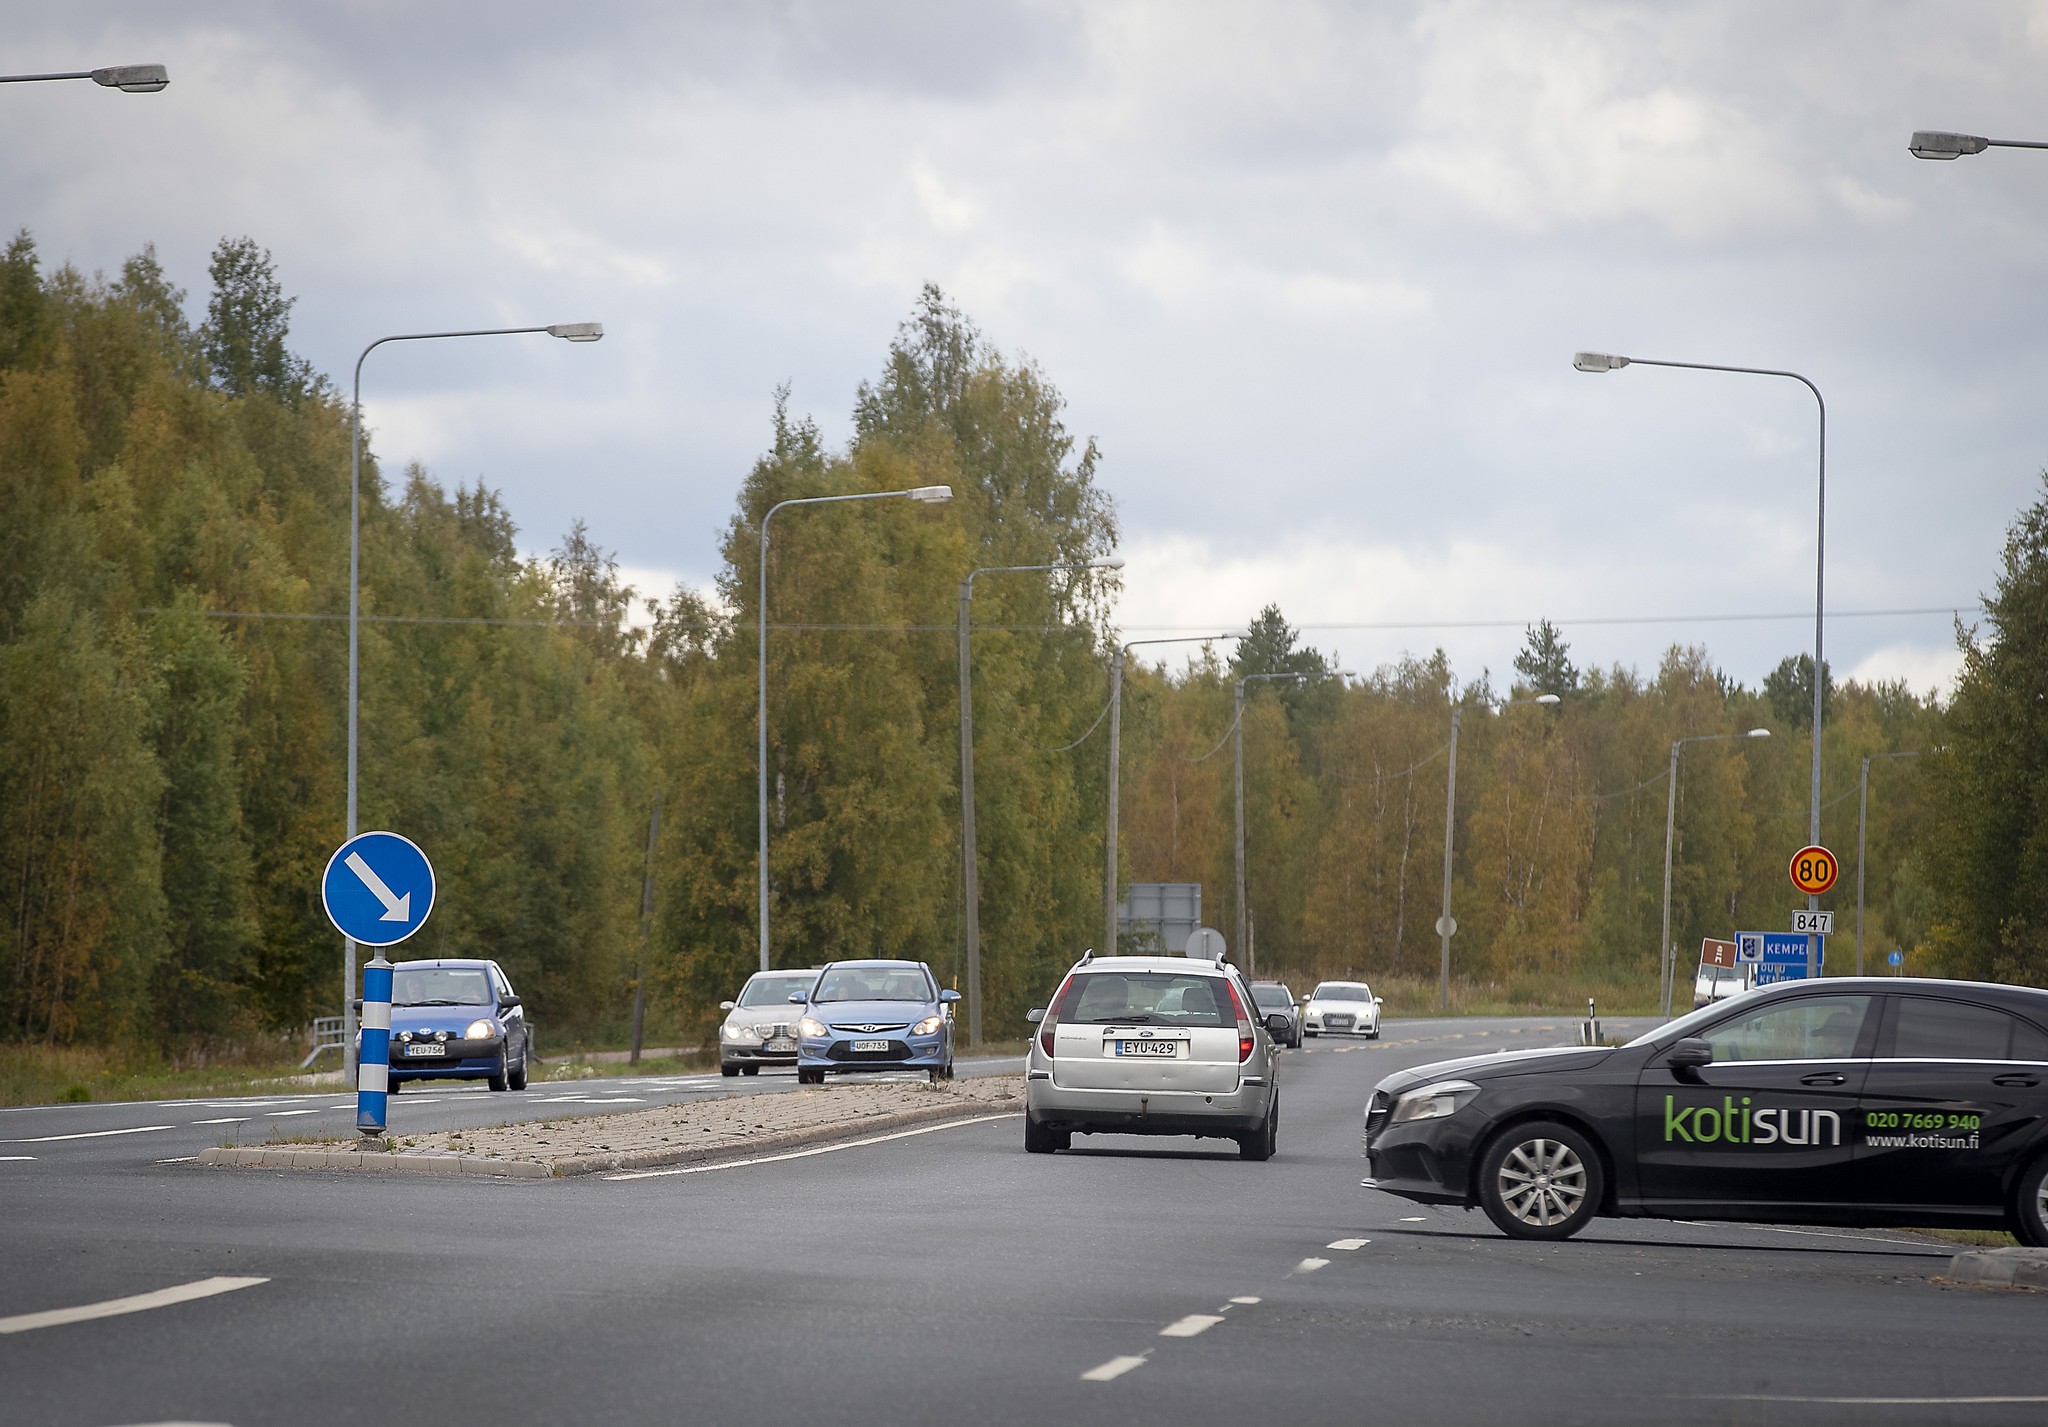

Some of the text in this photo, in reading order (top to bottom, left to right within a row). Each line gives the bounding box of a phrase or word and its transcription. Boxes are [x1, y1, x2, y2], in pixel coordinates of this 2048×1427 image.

[1799, 859, 1828, 881] 80
[1797, 914, 1828, 931] 847
[1766, 943, 1809, 955] KEMPE
[1760, 963, 1786, 974] OUU
[1124, 1042, 1174, 1054] EYU-429
[1665, 1095, 1841, 1145] kotisun
[1867, 1112, 1980, 1130] 020 7669 940
[1865, 1131, 1979, 1149] www.kotisun.fi
